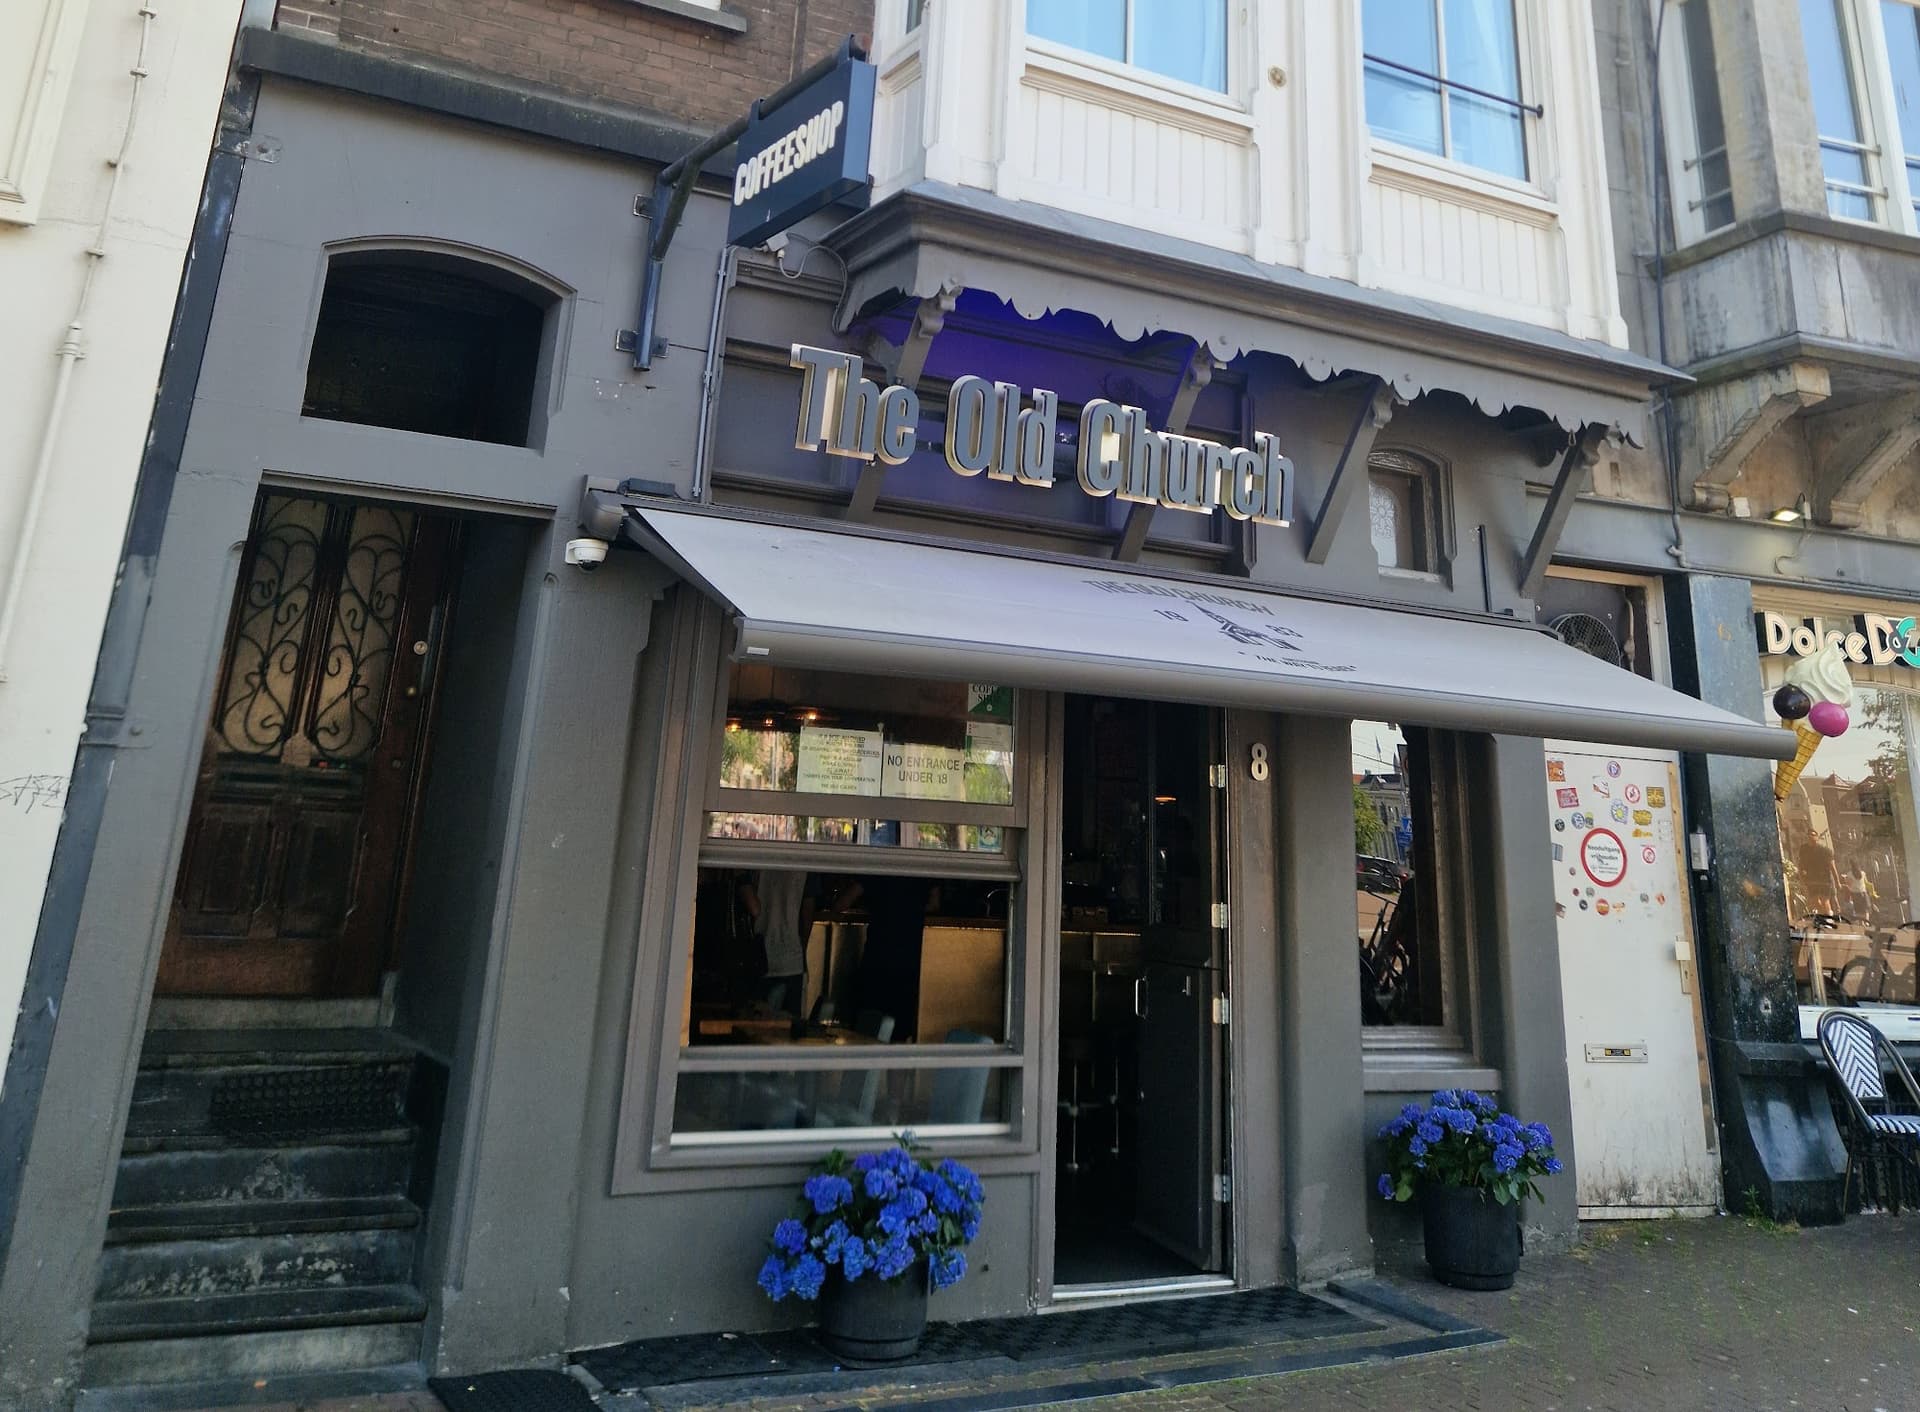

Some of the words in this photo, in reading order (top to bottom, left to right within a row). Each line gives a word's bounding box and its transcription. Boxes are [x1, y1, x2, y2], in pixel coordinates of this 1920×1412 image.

[733, 100, 844, 206] COFFEESHOP
[790, 343, 919, 465] The
[944, 374, 1058, 488] Old
[1076, 398, 1295, 528] Church
[1081, 580, 1138, 594] THE
[1169, 587, 1275, 616] CHURCH
[1764, 610, 1868, 665] Dolce
[887, 754, 903, 767] NO
[906, 756, 960, 771] ENTRANCE
[898, 770, 933, 784] UNDER
[937, 773, 948, 785] 18
[1251, 742, 1269, 781] 8
